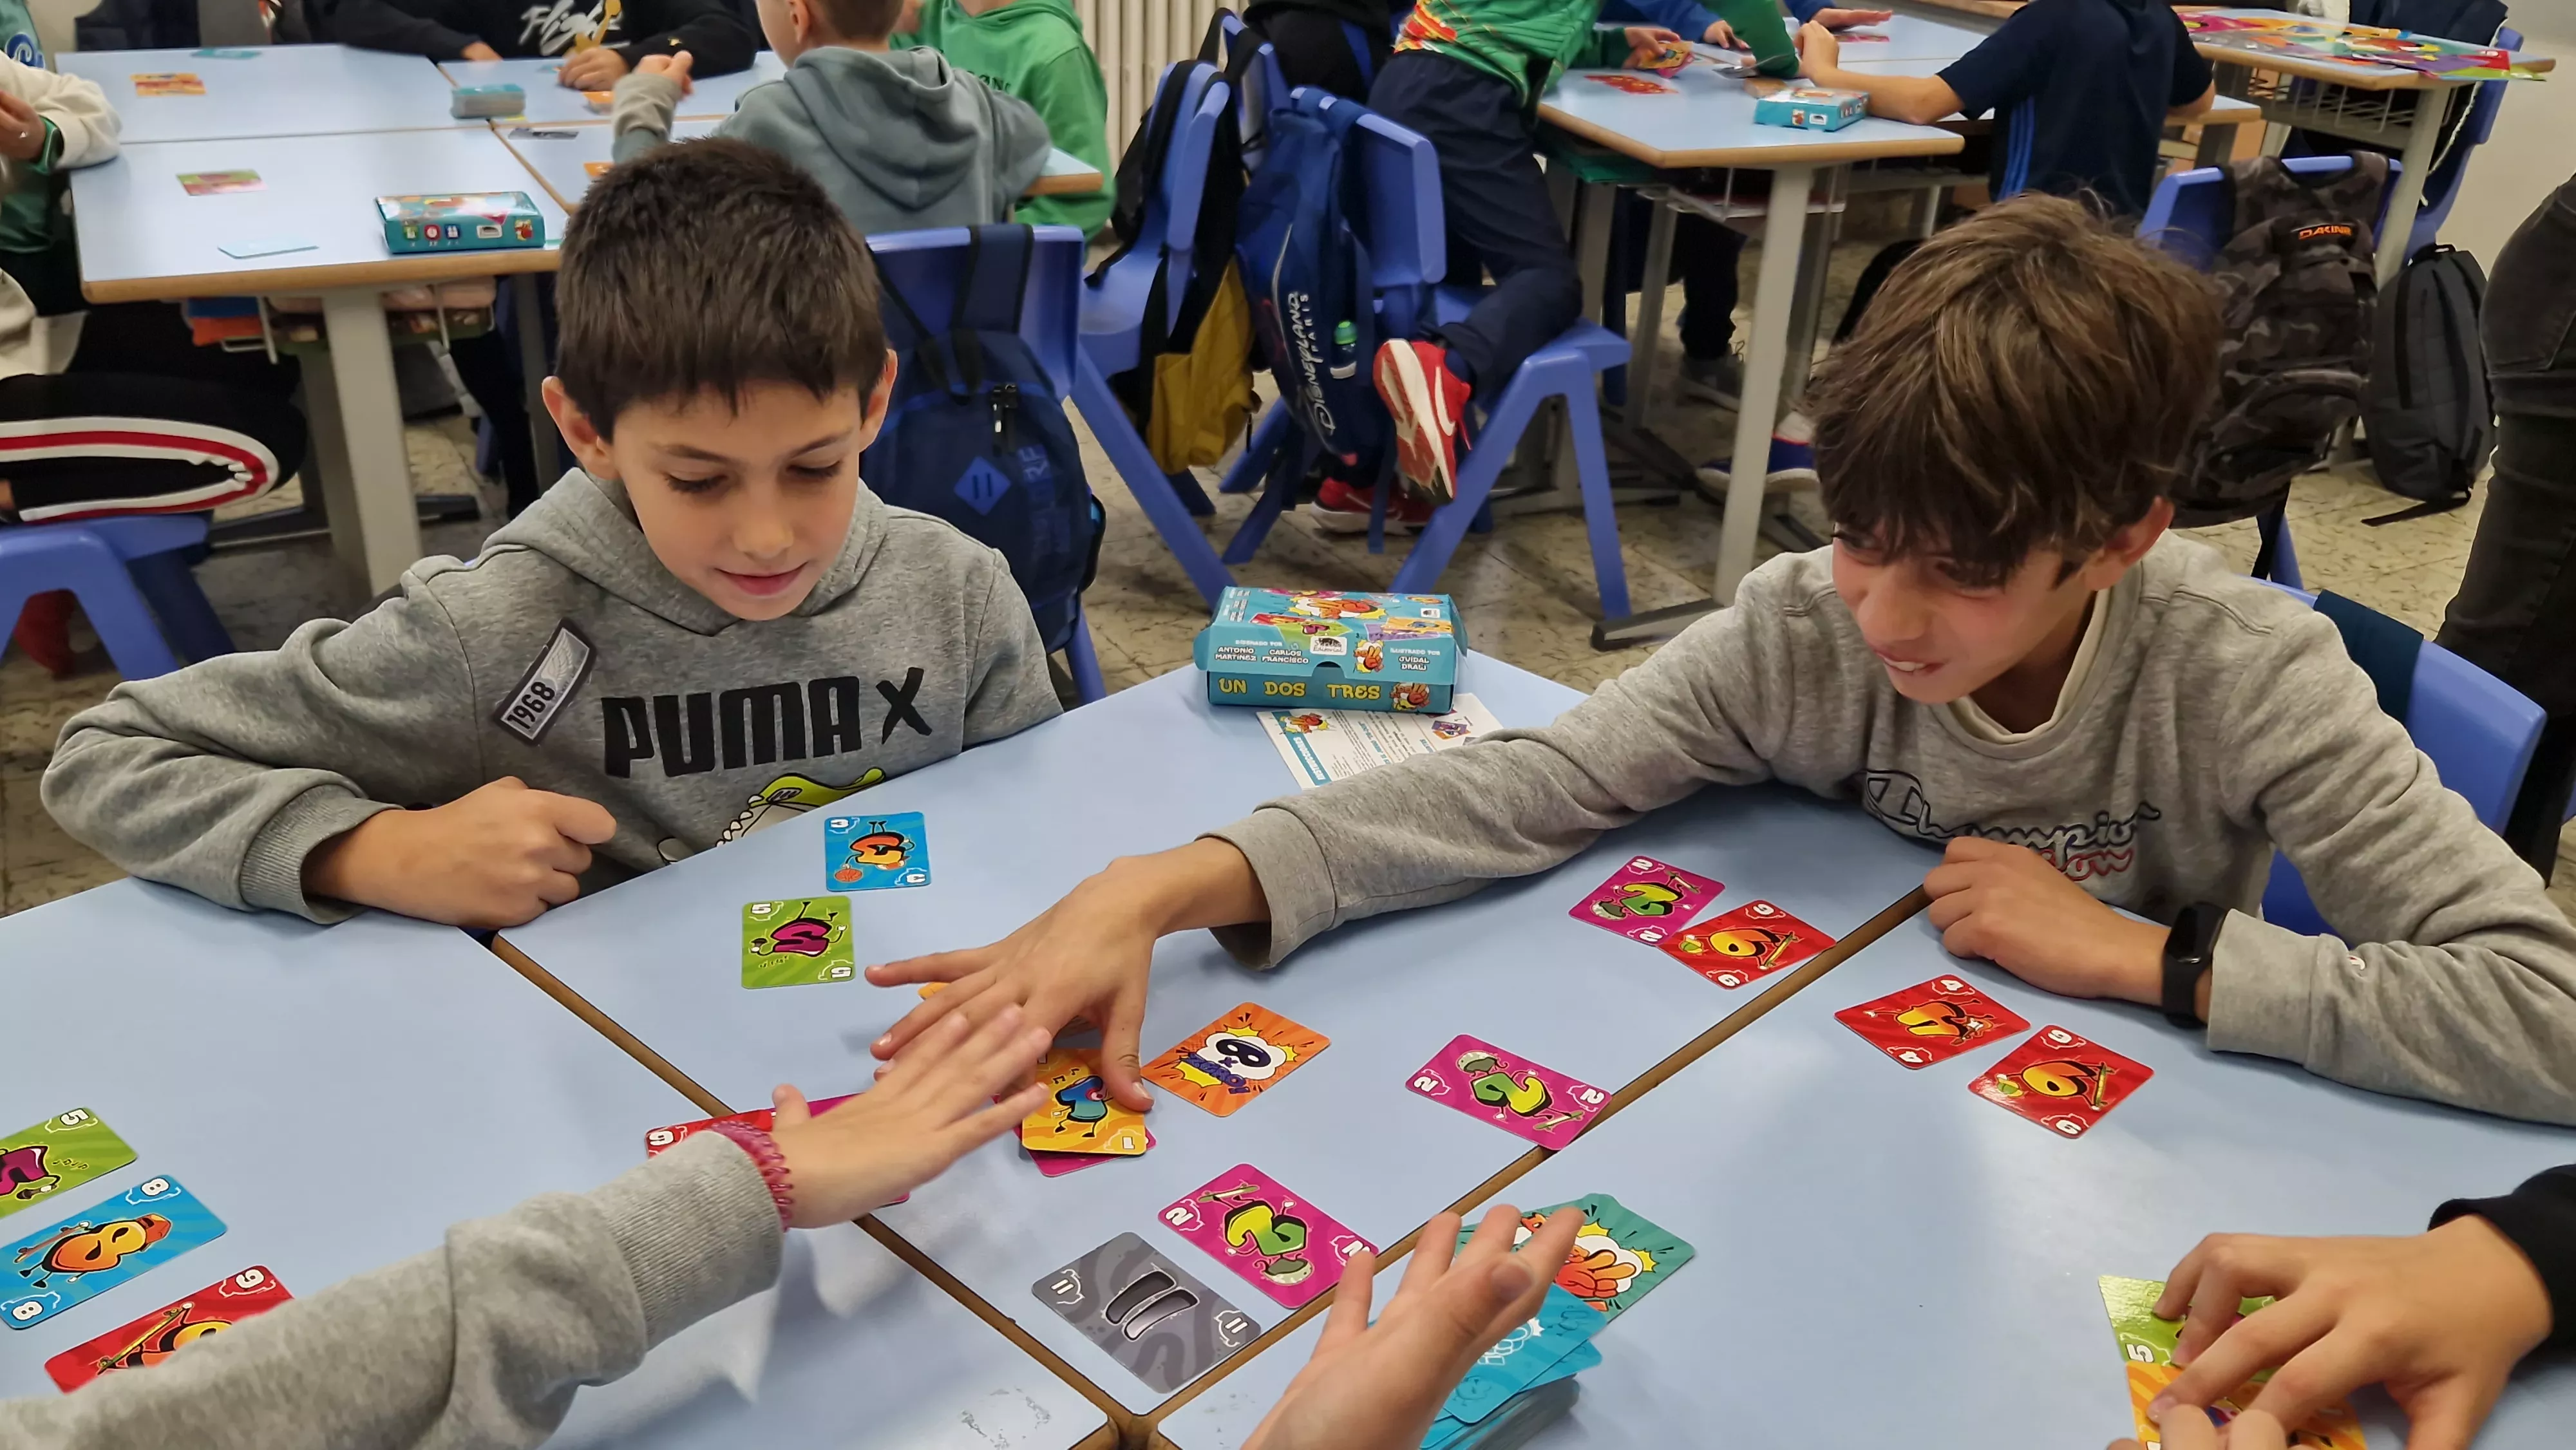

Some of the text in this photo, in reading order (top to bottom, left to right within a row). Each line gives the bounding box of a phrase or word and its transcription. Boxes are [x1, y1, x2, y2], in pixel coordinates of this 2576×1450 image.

[1400, 663, 1427, 672] DRAW
[1218, 678, 1381, 700] UN DOS TRES
[507, 681, 556, 730] 1968
[601, 666, 933, 778] PUMA X
[1631, 858, 1654, 871] 2
[750, 902, 773, 915] 5
[1639, 929, 1663, 943] 2
[829, 966, 853, 979] 5
[1939, 978, 1965, 993] 4
[1897, 1050, 1924, 1064] 4
[1412, 1076, 1439, 1093] 2
[1579, 1088, 1605, 1104] 2
[59, 1107, 90, 1126] 5
[140, 1177, 171, 1197] 8
[1164, 1207, 1195, 1227] 2
[11, 1301, 44, 1322] 8
[2125, 1342, 2155, 1363] 5
